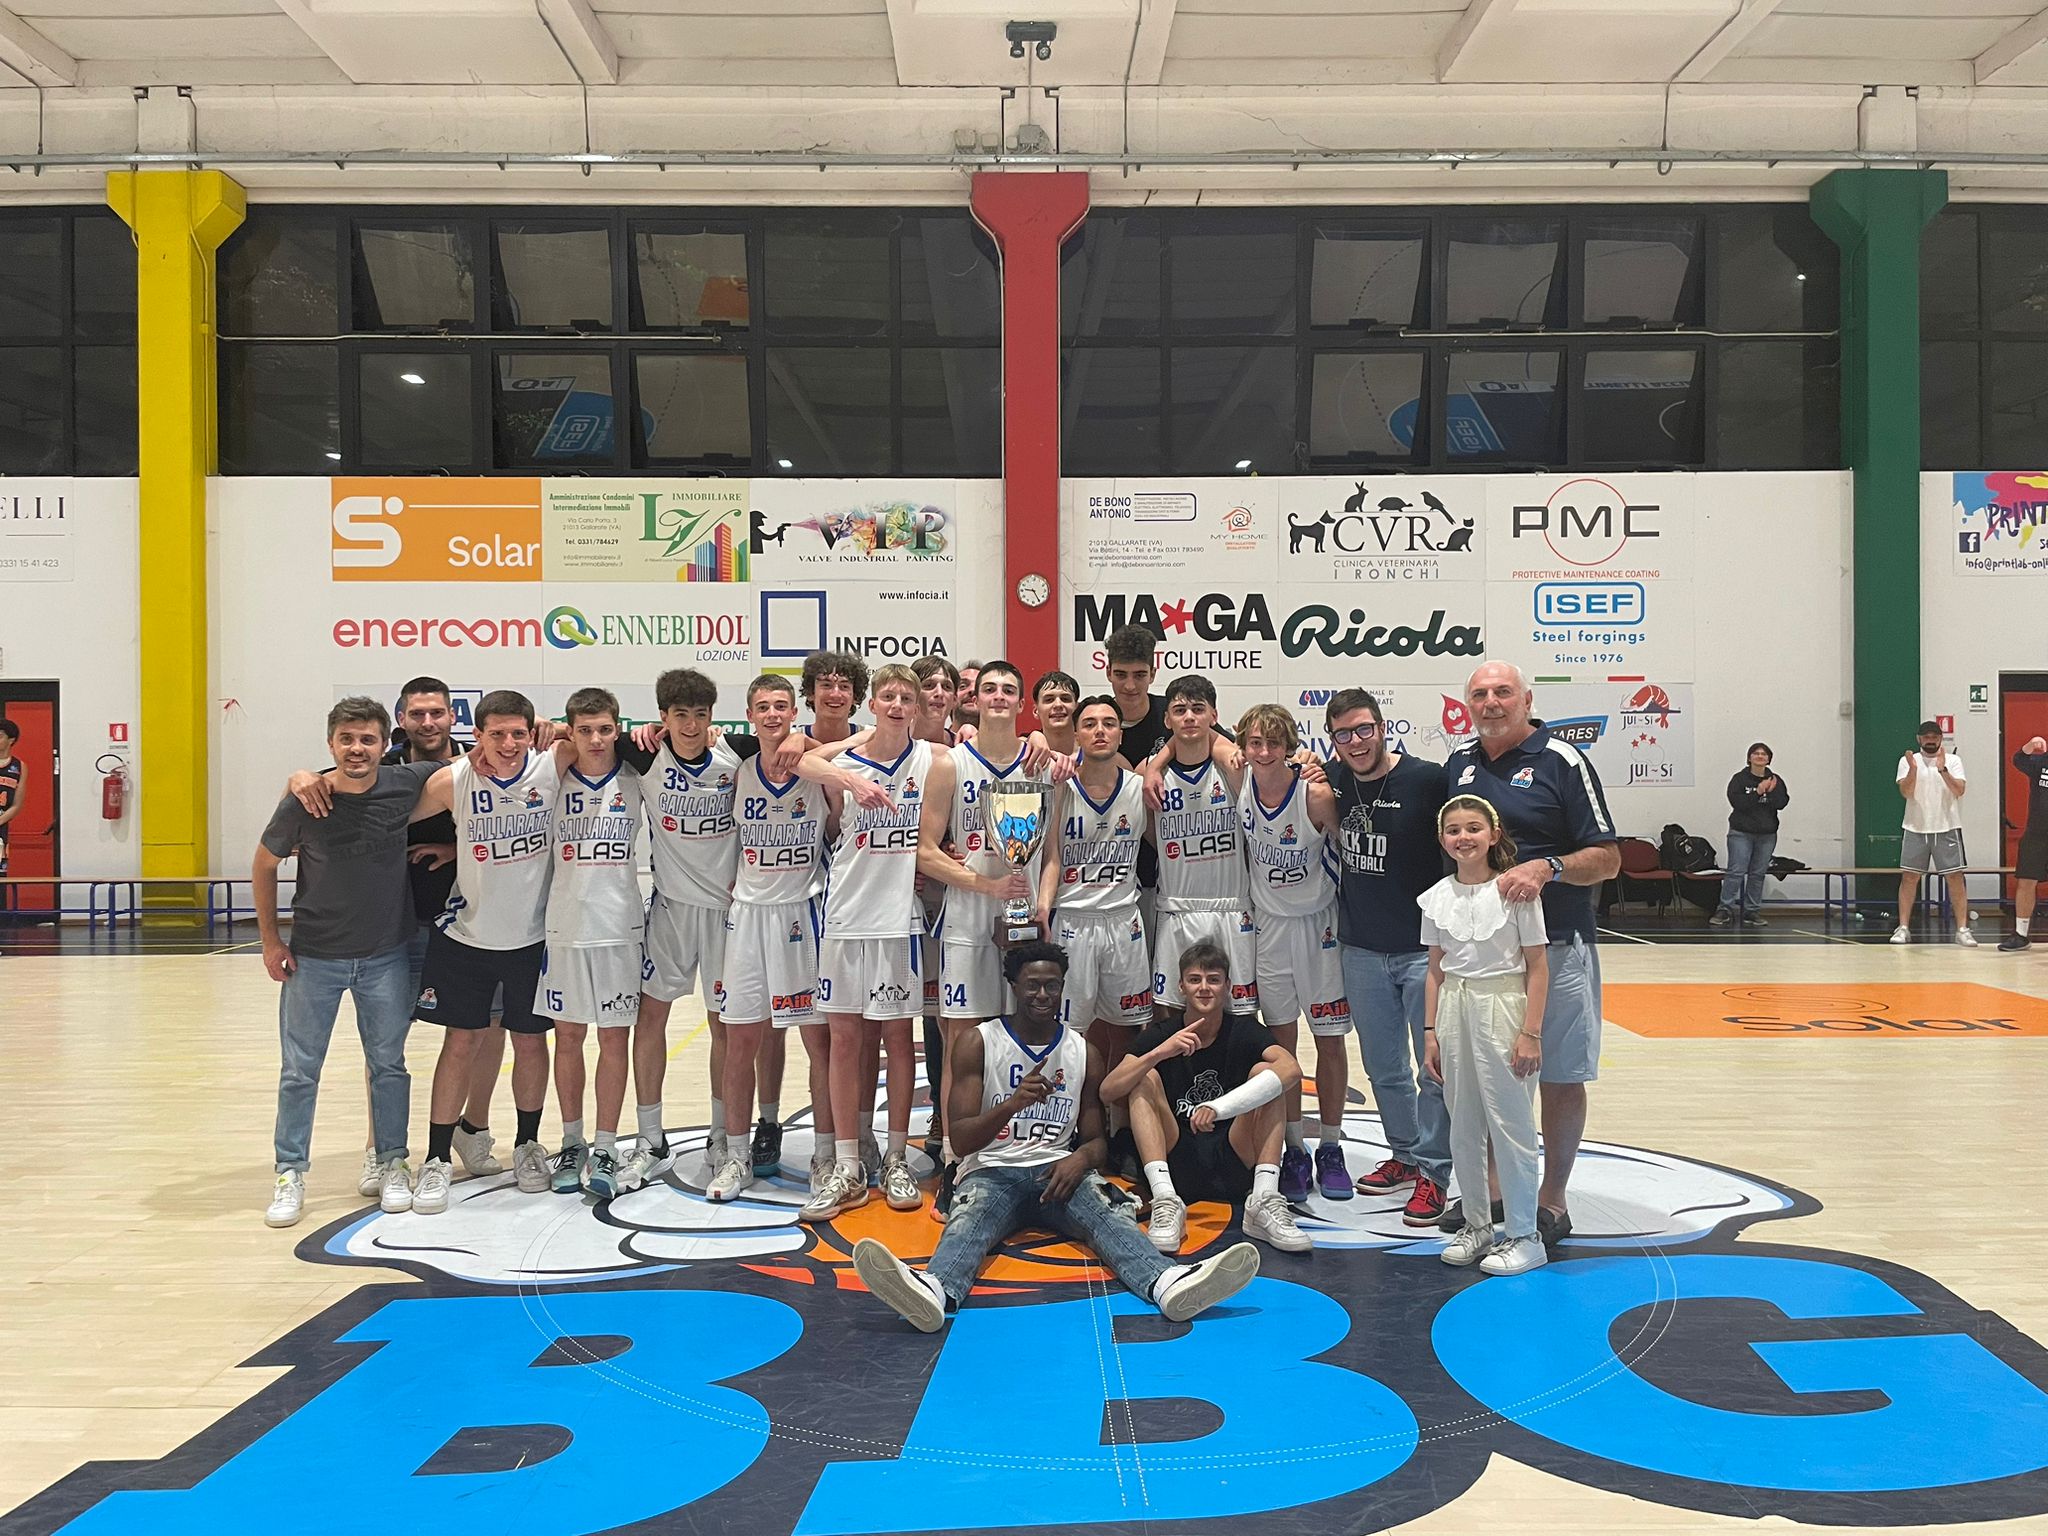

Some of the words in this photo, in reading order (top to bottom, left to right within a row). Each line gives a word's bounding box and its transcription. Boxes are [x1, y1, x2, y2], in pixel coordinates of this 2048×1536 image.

[549, 493, 600, 501] Amministrazione
[602, 493, 634, 501] Condomini
[672, 493, 742, 501] IMMOBILIARE
[1089, 497, 1101, 507] DE
[1104, 497, 1132, 507] BONO
[1089, 509, 1132, 519] ANTONIO
[1513, 505, 1660, 538] PMC
[815, 511, 946, 550] VIP
[1333, 515, 1437, 553] CVR
[448, 533, 541, 568] Solar
[1149, 539, 1163, 547] (VA)
[20, 559, 29, 567] 15
[31, 559, 41, 567] 41
[42, 559, 59, 567] 423
[1333, 560, 1377, 568] CLINICA
[1380, 559, 1439, 567] VETERINARIA
[1355, 568, 1439, 579] RONCHI
[1512, 571, 1561, 579] PROTECTIVE
[1625, 570, 1660, 578] COATING
[879, 590, 949, 600] www.infocia.it
[1545, 593, 1634, 614] ISEF
[601, 614, 750, 646] ENNEBIDOL
[1280, 604, 1485, 658] Ricola
[1532, 631, 1571, 642] Steel
[1578, 630, 1646, 645] forgings
[696, 650, 749, 661] LOZIONE
[835, 636, 948, 657] INFOCIA
[1092, 650, 1262, 669] STCULTURE
[1554, 654, 1587, 663] Since
[1592, 654, 1624, 663] 1976
[1554, 727, 1594, 741] ARES
[664, 767, 689, 792] 39
[472, 790, 493, 814] 19
[565, 792, 584, 815] 15
[744, 797, 768, 820] 82
[468, 809, 552, 842] GALLARATE
[559, 817, 634, 842] GALLARATE
[741, 820, 817, 847] GALLARATE
[1065, 816, 1083, 839] 41
[1160, 806, 1237, 840] GALLARATE
[492, 832, 548, 860] LASI
[870, 829, 918, 849] LAS
[1183, 832, 1236, 857] LASI
[1368, 834, 1388, 857] TO
[577, 842, 630, 860] LASI
[760, 845, 815, 867] LASI
[1268, 866, 1309, 884] ASI
[642, 954, 655, 981] 9
[546, 989, 563, 1011] 15
[720, 990, 727, 1012] 2
[877, 991, 900, 1001] CVR
[944, 984, 967, 1007] 34
[1721, 1014, 2022, 1032] Solar
[47, 1255, 2048, 1536] BBG
